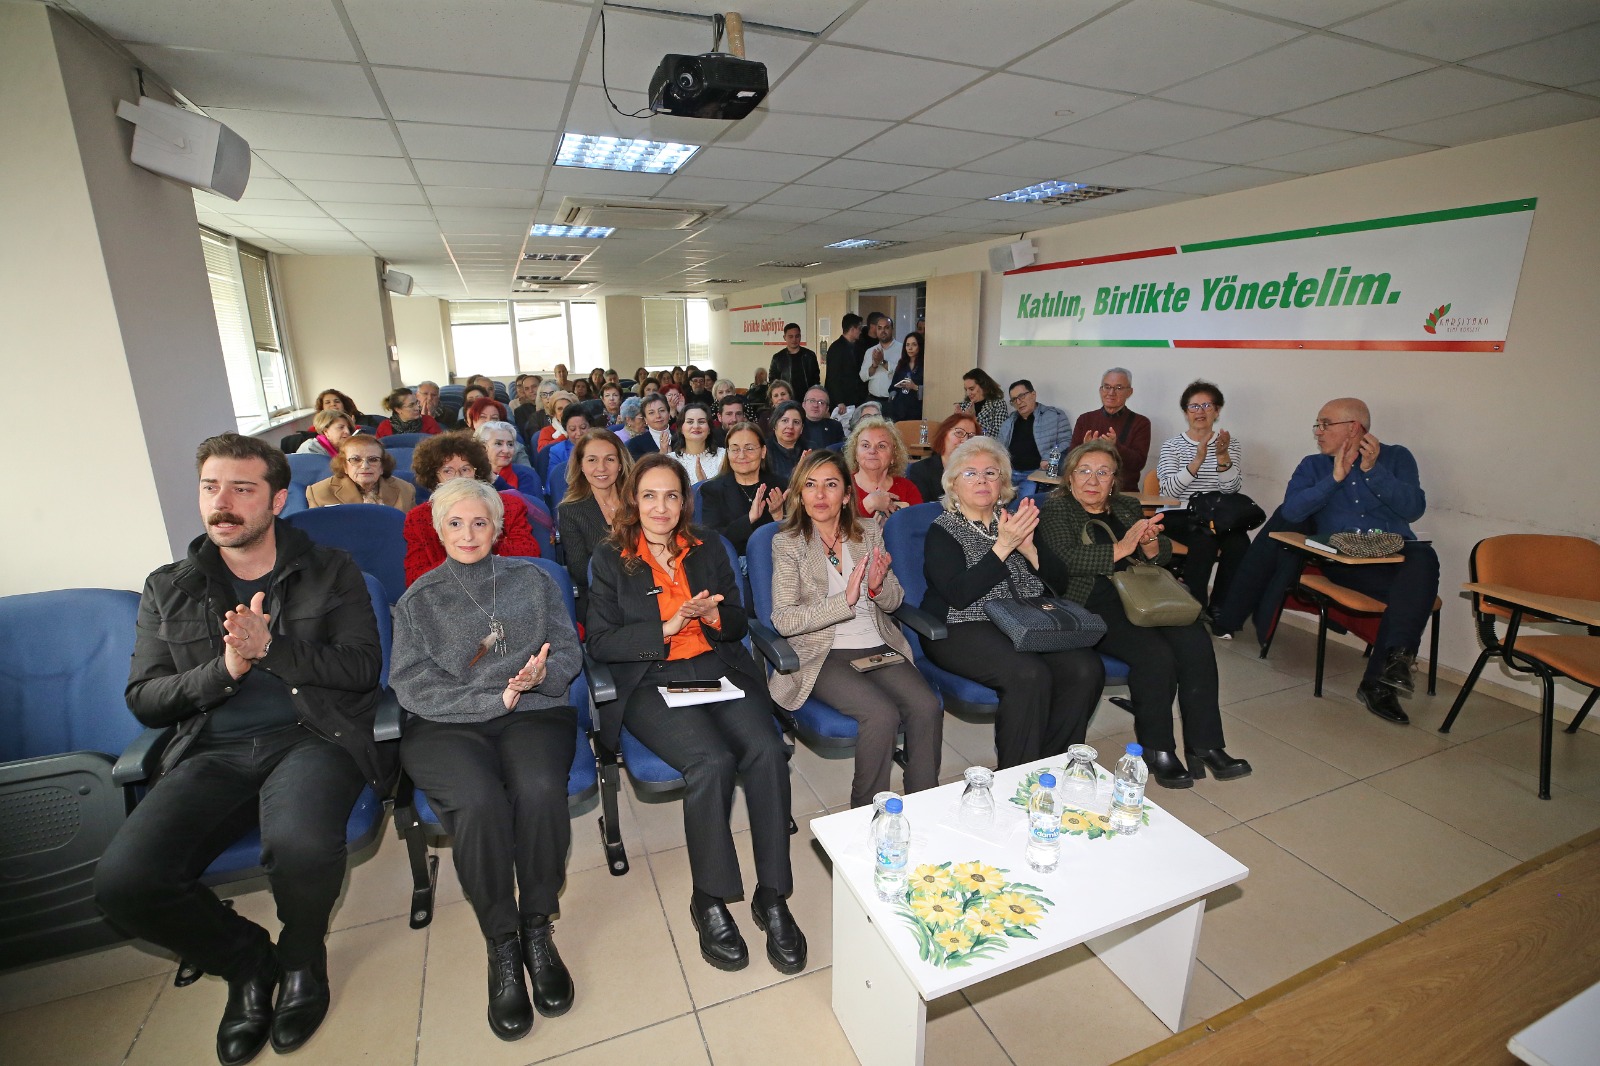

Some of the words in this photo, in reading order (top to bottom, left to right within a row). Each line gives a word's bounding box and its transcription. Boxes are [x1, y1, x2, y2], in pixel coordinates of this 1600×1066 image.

[1017, 291, 1086, 322] Katılın,
[1093, 282, 1191, 315] Birlikte
[1200, 266, 1401, 312] Yönetelim.
[743, 319, 760, 333] Birlikte
